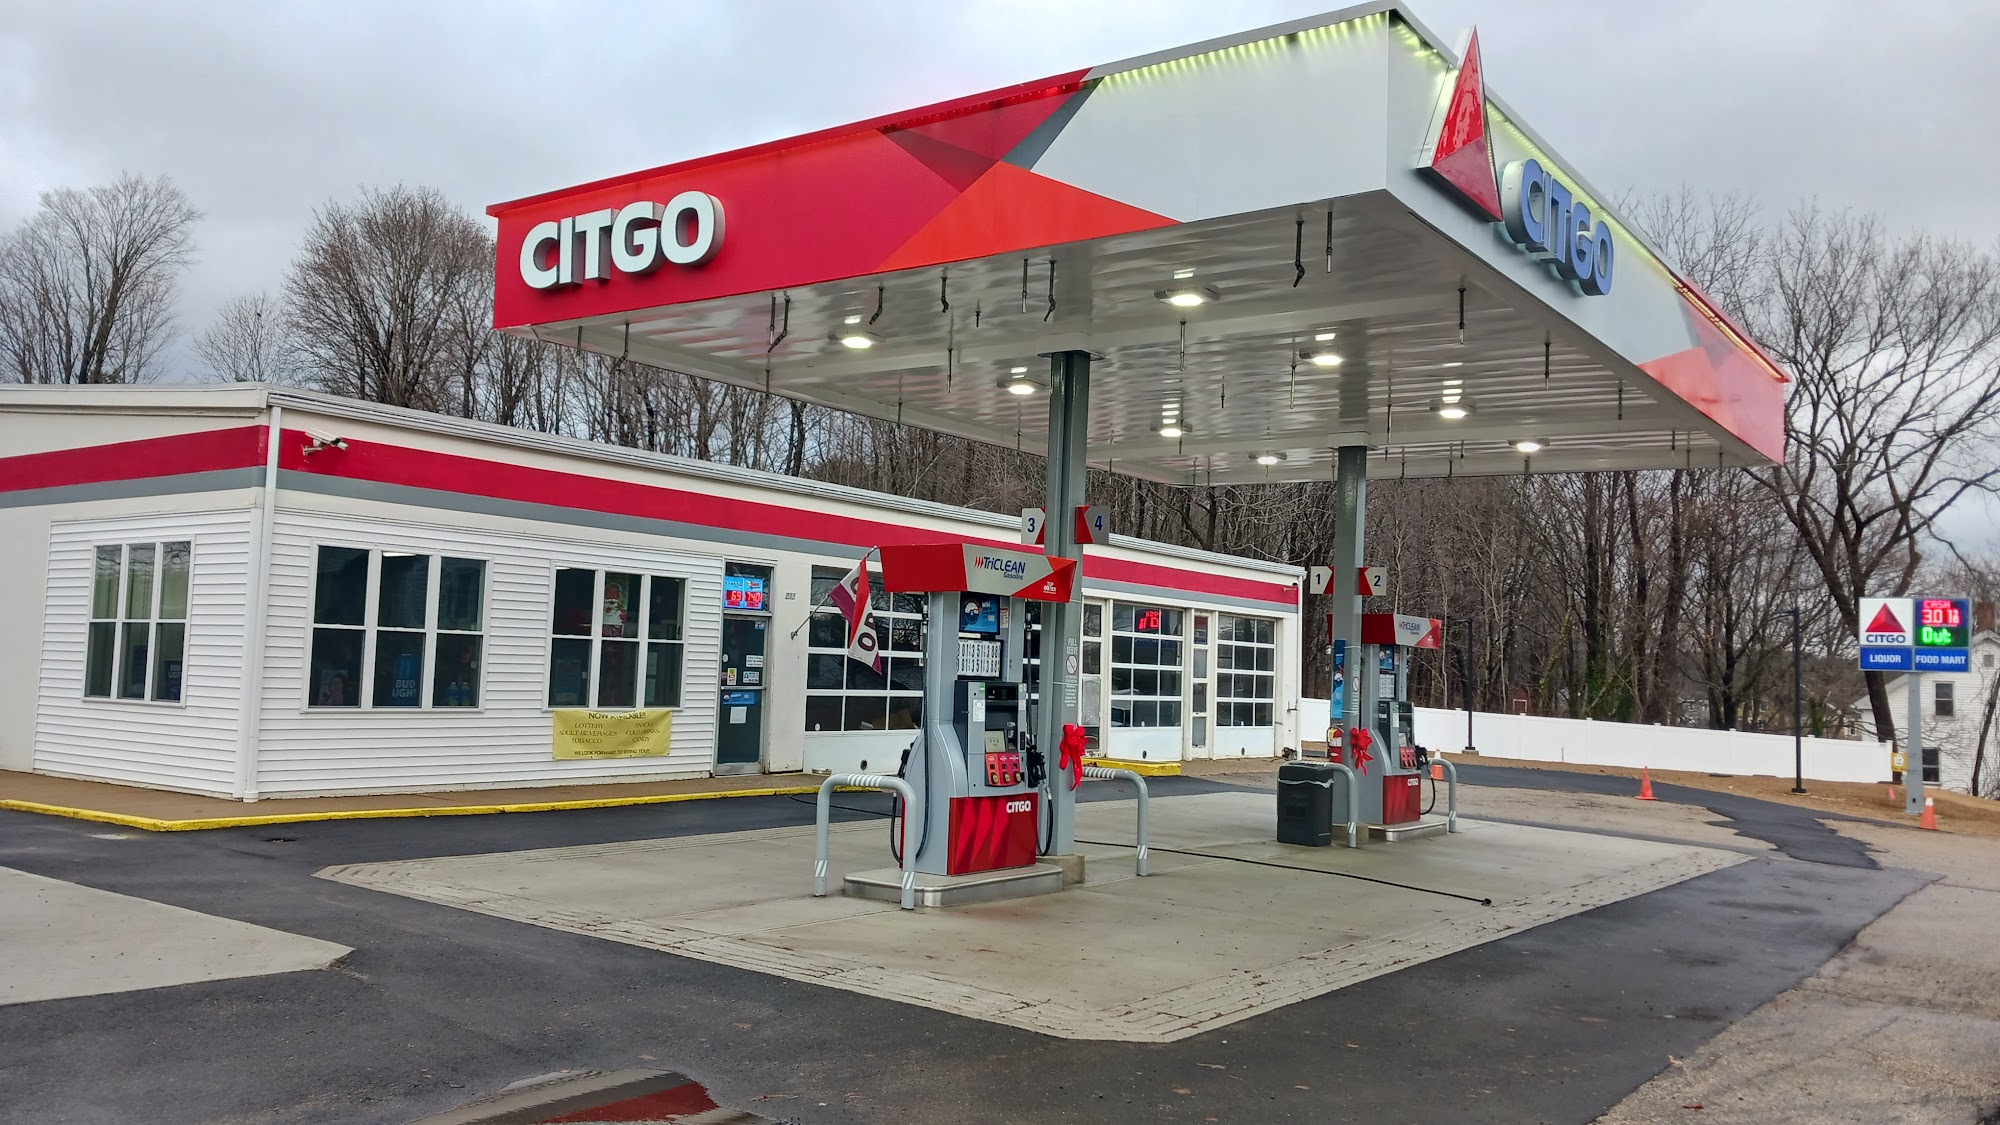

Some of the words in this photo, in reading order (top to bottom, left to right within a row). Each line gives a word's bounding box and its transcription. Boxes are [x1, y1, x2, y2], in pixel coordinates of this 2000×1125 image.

[1512, 158, 1614, 296] CITGO
[520, 190, 722, 289] CITGO
[1027, 517, 1036, 533] 3
[1094, 515, 1103, 531] 4
[983, 556, 1026, 574] TriCLEAN
[1315, 573, 1321, 585] 1
[1373, 575, 1381, 586] 2
[731, 590, 742, 601] 69
[1923, 600, 1951, 609] CASH
[1866, 634, 1906, 643] CITGO
[1922, 627, 1951, 643] Out
[1869, 654, 1902, 663] LIQUOR
[1916, 655, 1939, 664] FOOD
[1941, 655, 1966, 664] MART
[395, 680, 416, 689] BUD
[588, 712, 608, 720] NOW
[1006, 800, 1032, 813] CITGO
